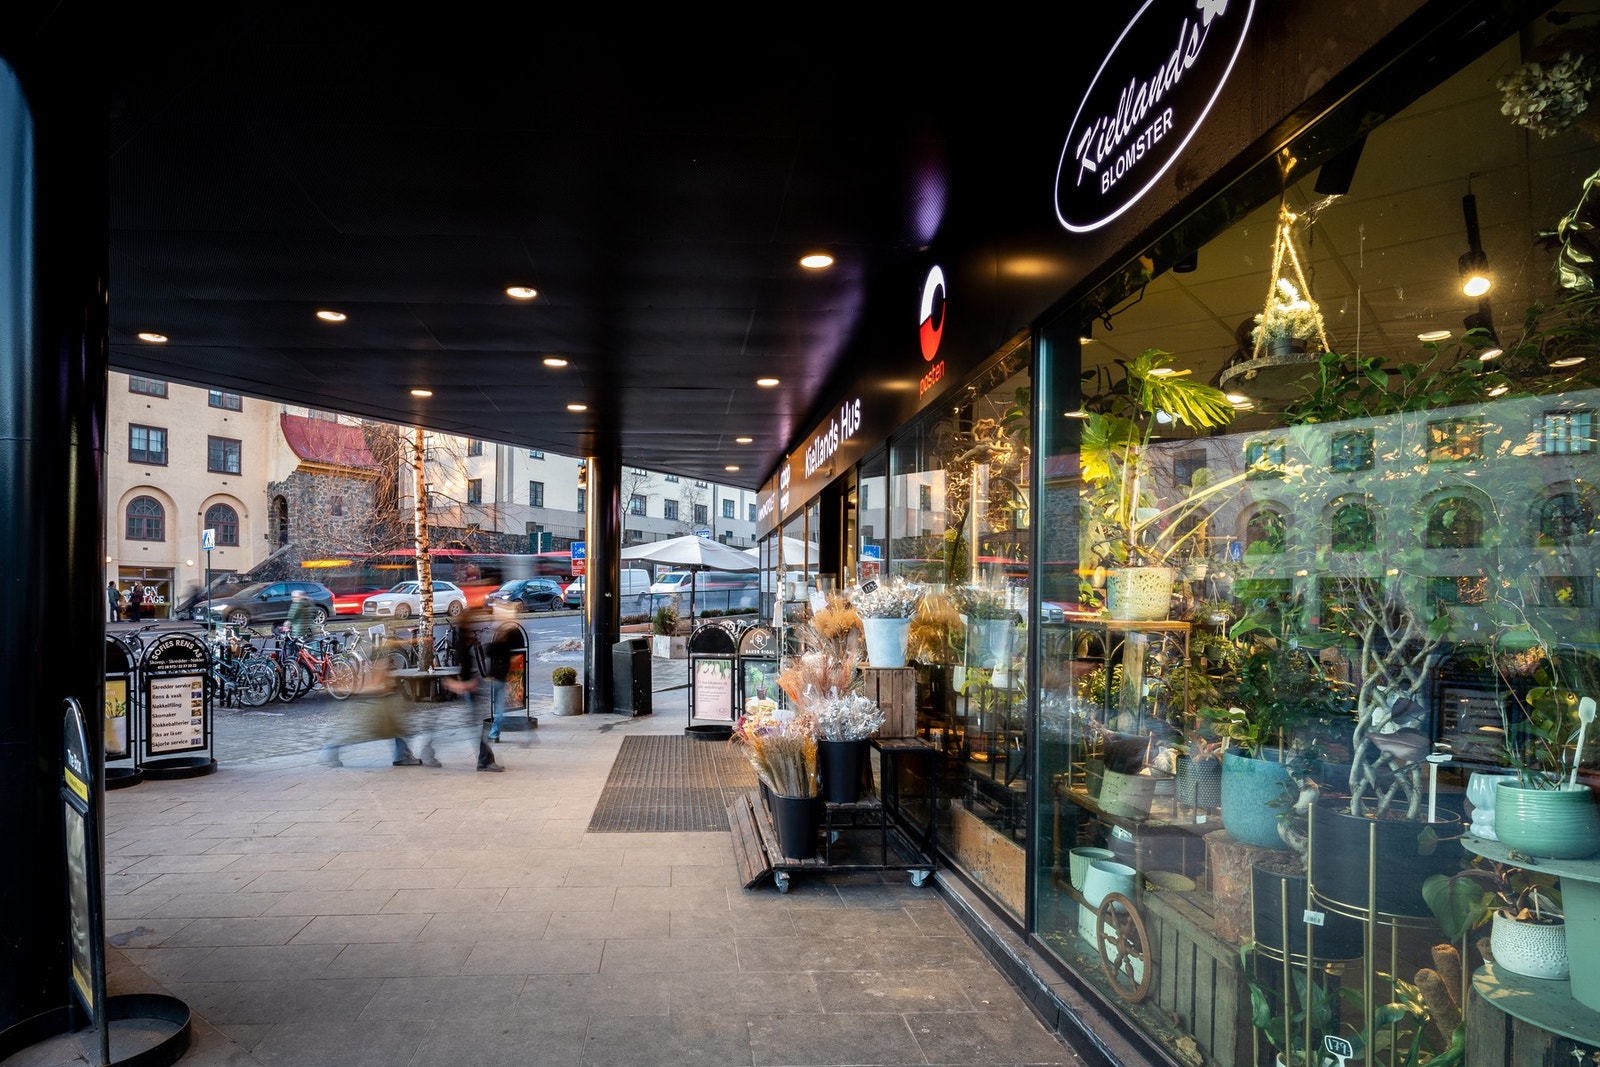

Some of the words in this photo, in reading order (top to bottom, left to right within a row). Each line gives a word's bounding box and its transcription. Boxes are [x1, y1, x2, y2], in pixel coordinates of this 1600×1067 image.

[1076, 18, 1200, 186] Kiellands
[1102, 107, 1173, 195] BLOMSTER
[919, 360, 945, 400] posten
[805, 418, 839, 480] Kiellands
[841, 398, 860, 445] Hus
[151, 640, 174, 660] SOFIES
[176, 640, 194, 649] RENS
[193, 649, 203, 658] AS
